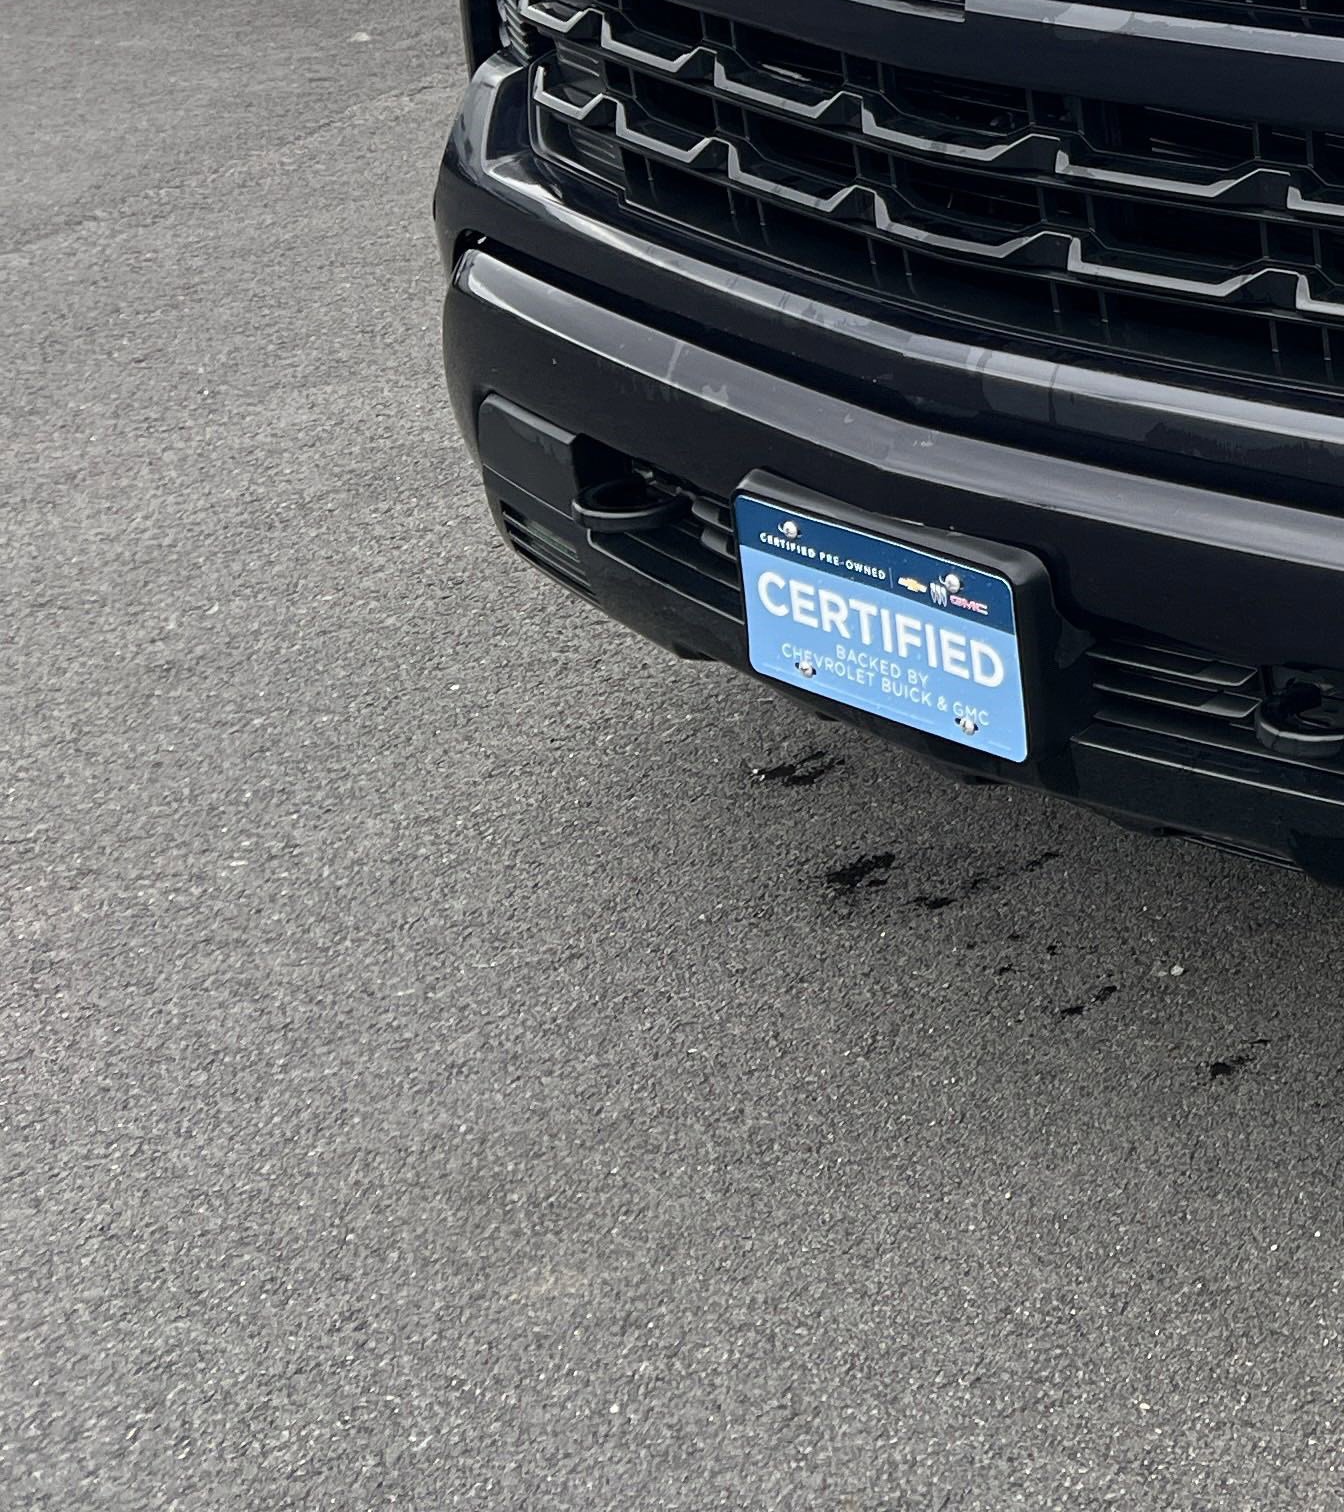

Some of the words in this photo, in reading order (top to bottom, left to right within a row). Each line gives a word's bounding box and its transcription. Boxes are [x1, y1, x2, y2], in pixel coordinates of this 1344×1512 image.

[759, 532, 816, 559] CERTIFIED
[819, 551, 887, 581] PRE-OWNED
[757, 571, 1006, 689] CERTIFIED
[781, 643, 875, 687] CHEVROLET
[881, 677, 933, 708] BUICK
[936, 696, 949, 713] &
[952, 700, 991, 727] GMC
[835, 644, 901, 680] BACKED
[907, 668, 929, 689] BY
